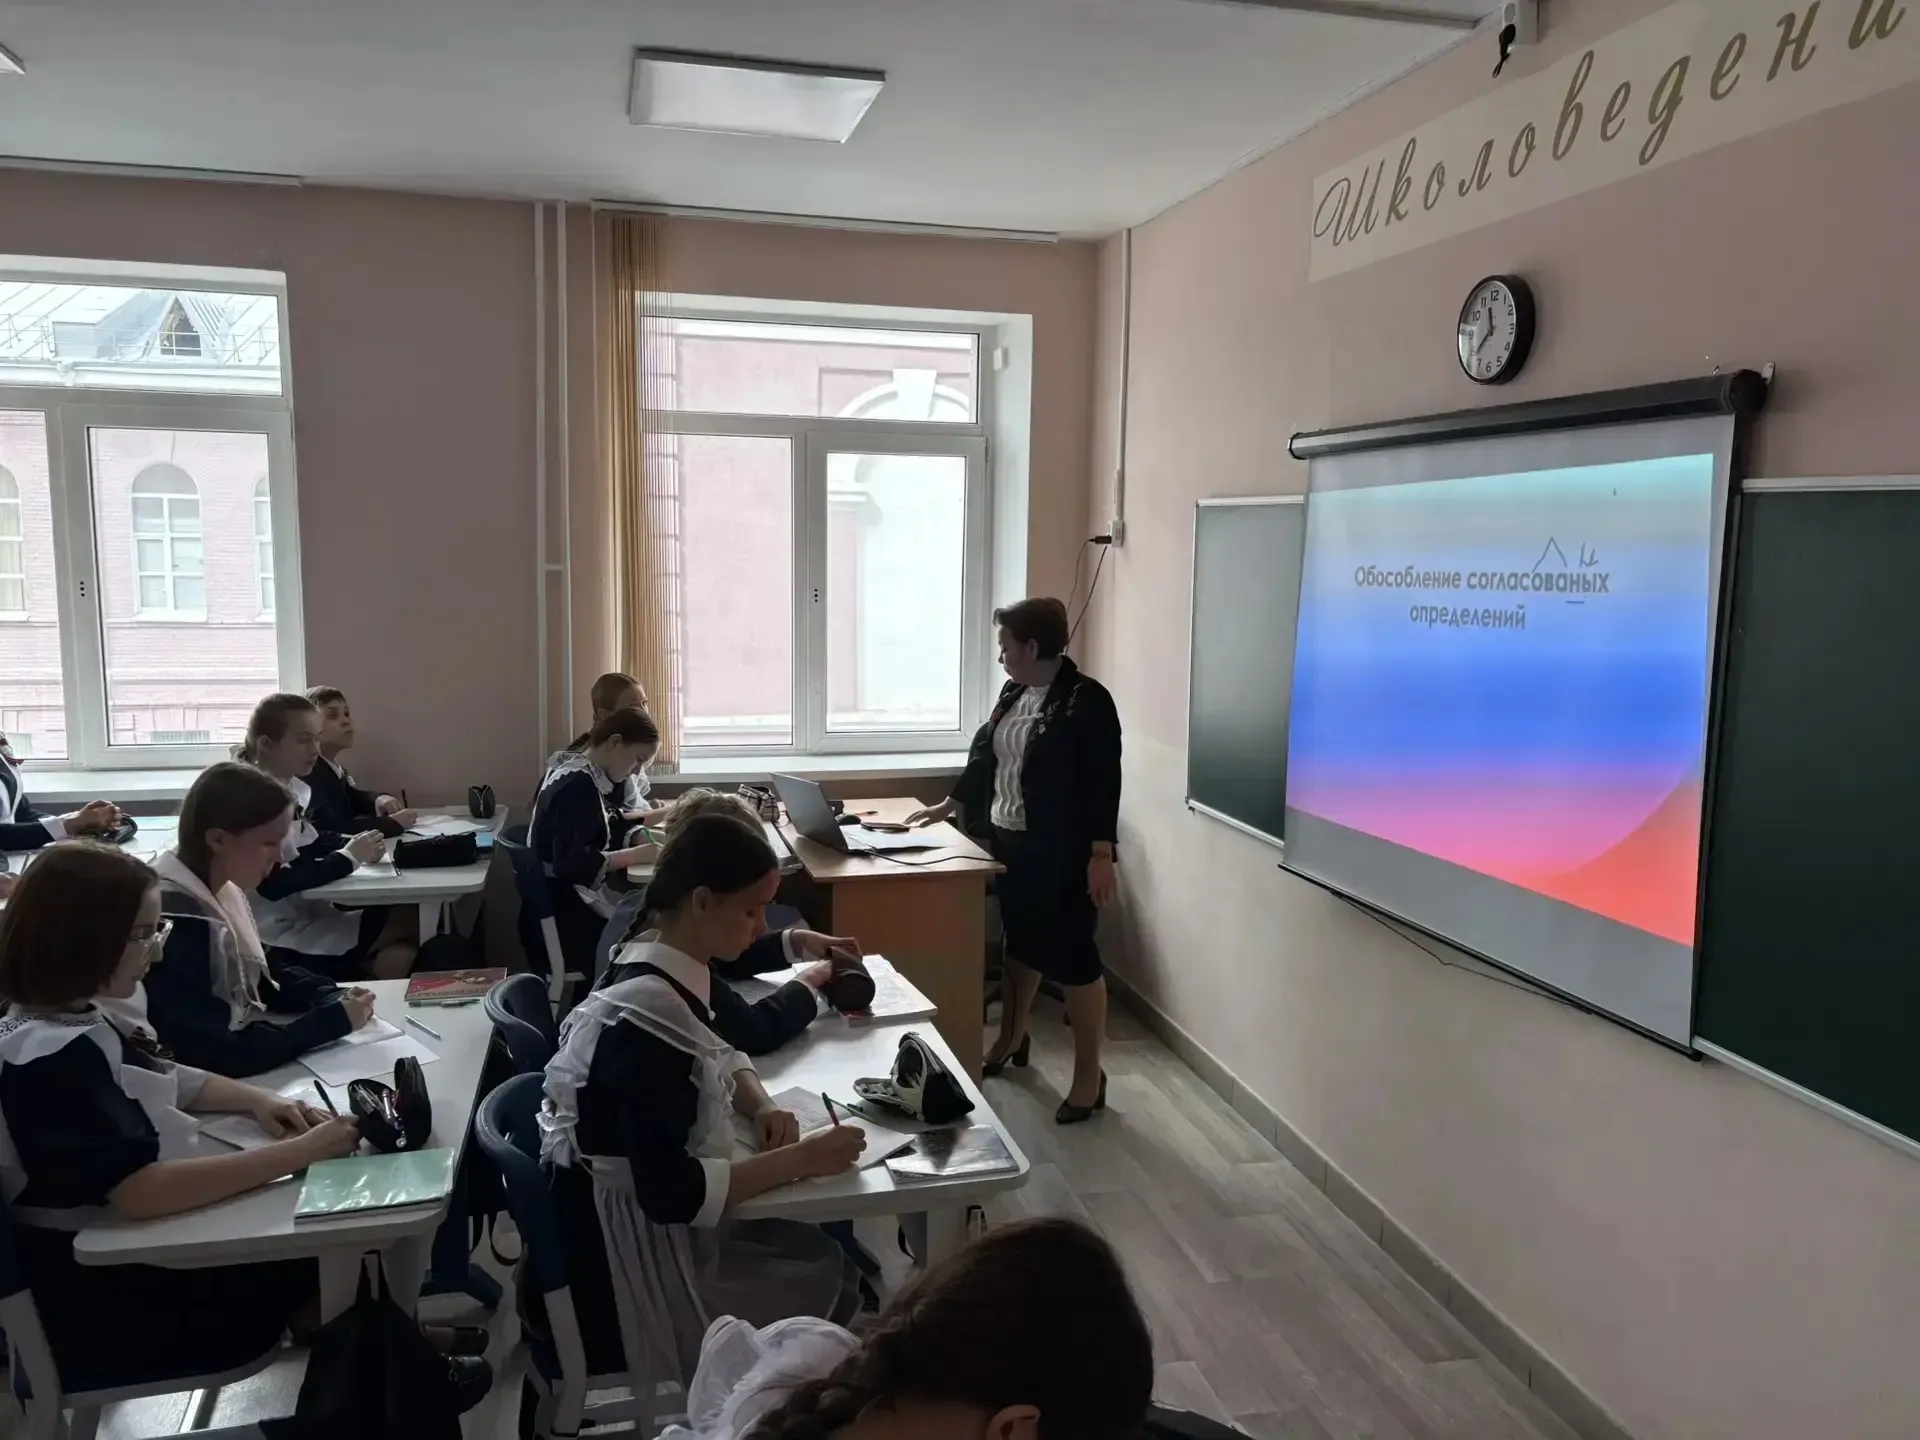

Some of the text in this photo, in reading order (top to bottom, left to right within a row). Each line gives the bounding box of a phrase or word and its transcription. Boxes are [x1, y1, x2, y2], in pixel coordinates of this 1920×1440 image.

[1490, 289, 1500, 302] 12
[1480, 297, 1487, 309] 11
[1472, 310, 1481, 322] 10
[1507, 304, 1514, 316] 2
[1469, 329, 1475, 340] 9
[1508, 322, 1515, 335] 3
[1504, 342, 1511, 352] 4
[1476, 358, 1482, 371] 7
[1485, 362, 1492, 373] 6
[1496, 356, 1503, 367] 5
[1355, 565, 1611, 594] Обособление согласованых
[1409, 604, 1527, 629] определений
